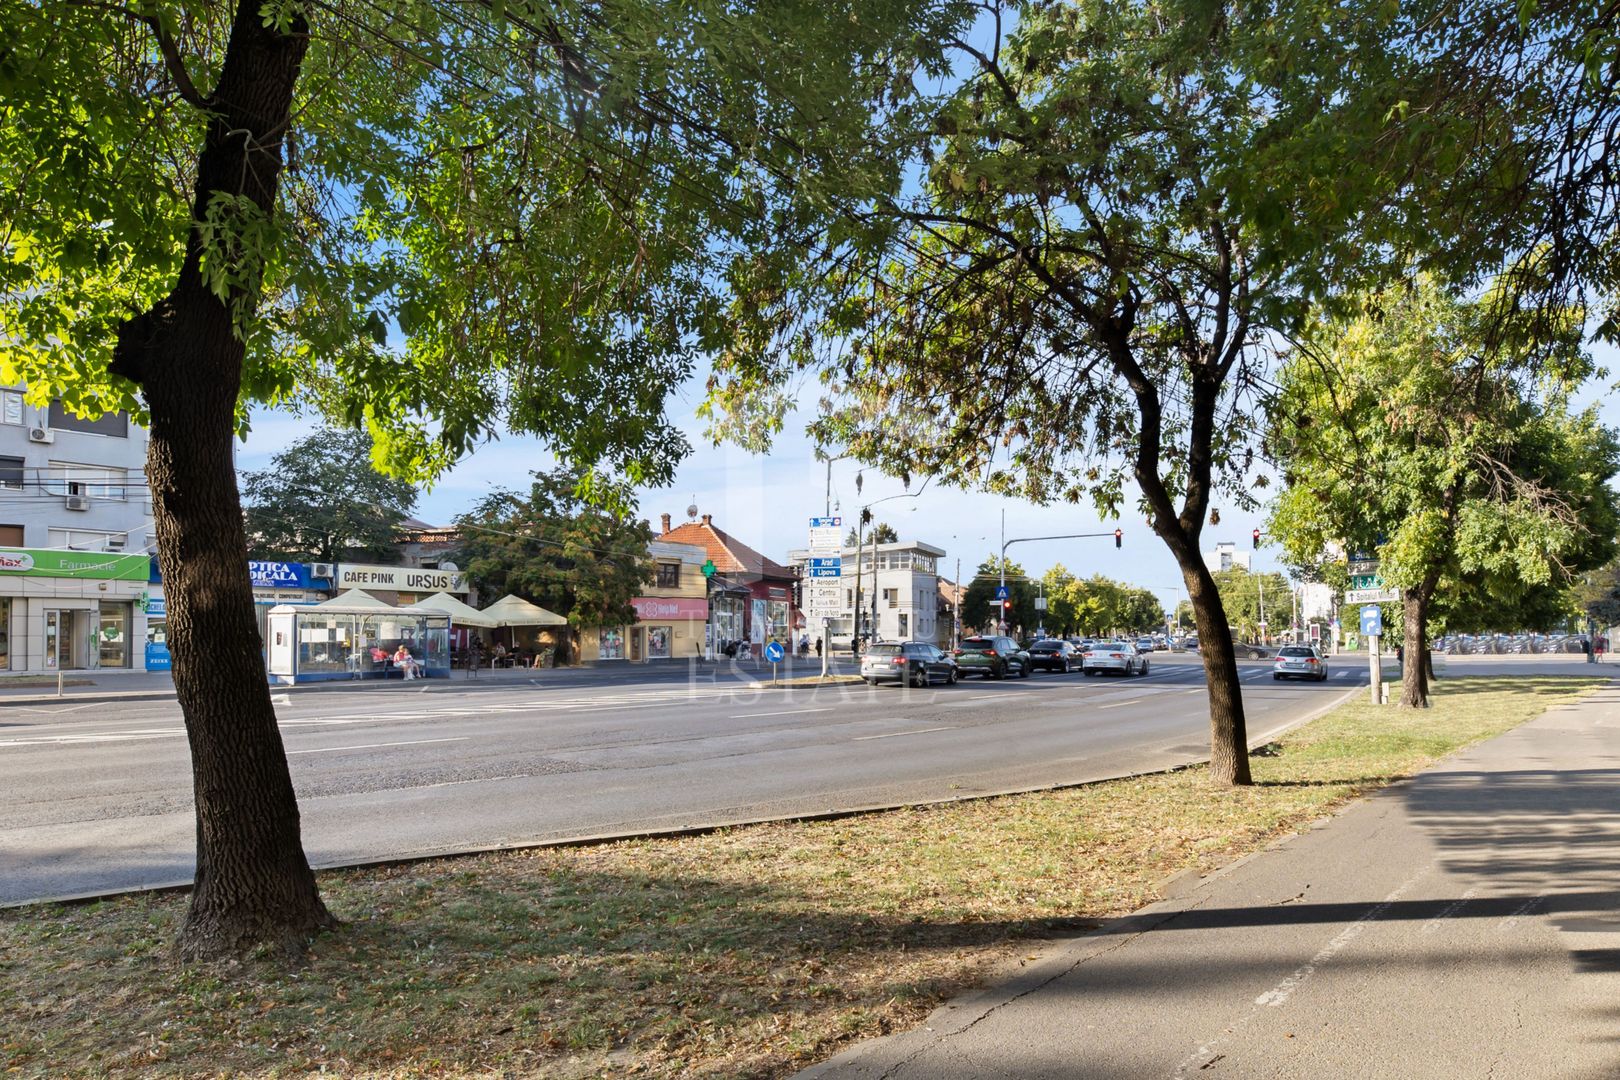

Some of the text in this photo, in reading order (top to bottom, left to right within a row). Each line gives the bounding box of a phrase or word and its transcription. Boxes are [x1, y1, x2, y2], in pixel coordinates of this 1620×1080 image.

[60, 560, 116, 571] Farmacie
[821, 558, 833, 566] Arad
[818, 569, 836, 577] Lipova
[344, 571, 394, 584] CAFE PINK
[407, 574, 448, 589] URSUS
[817, 579, 838, 587] Aeroport
[819, 588, 836, 596] Centru
